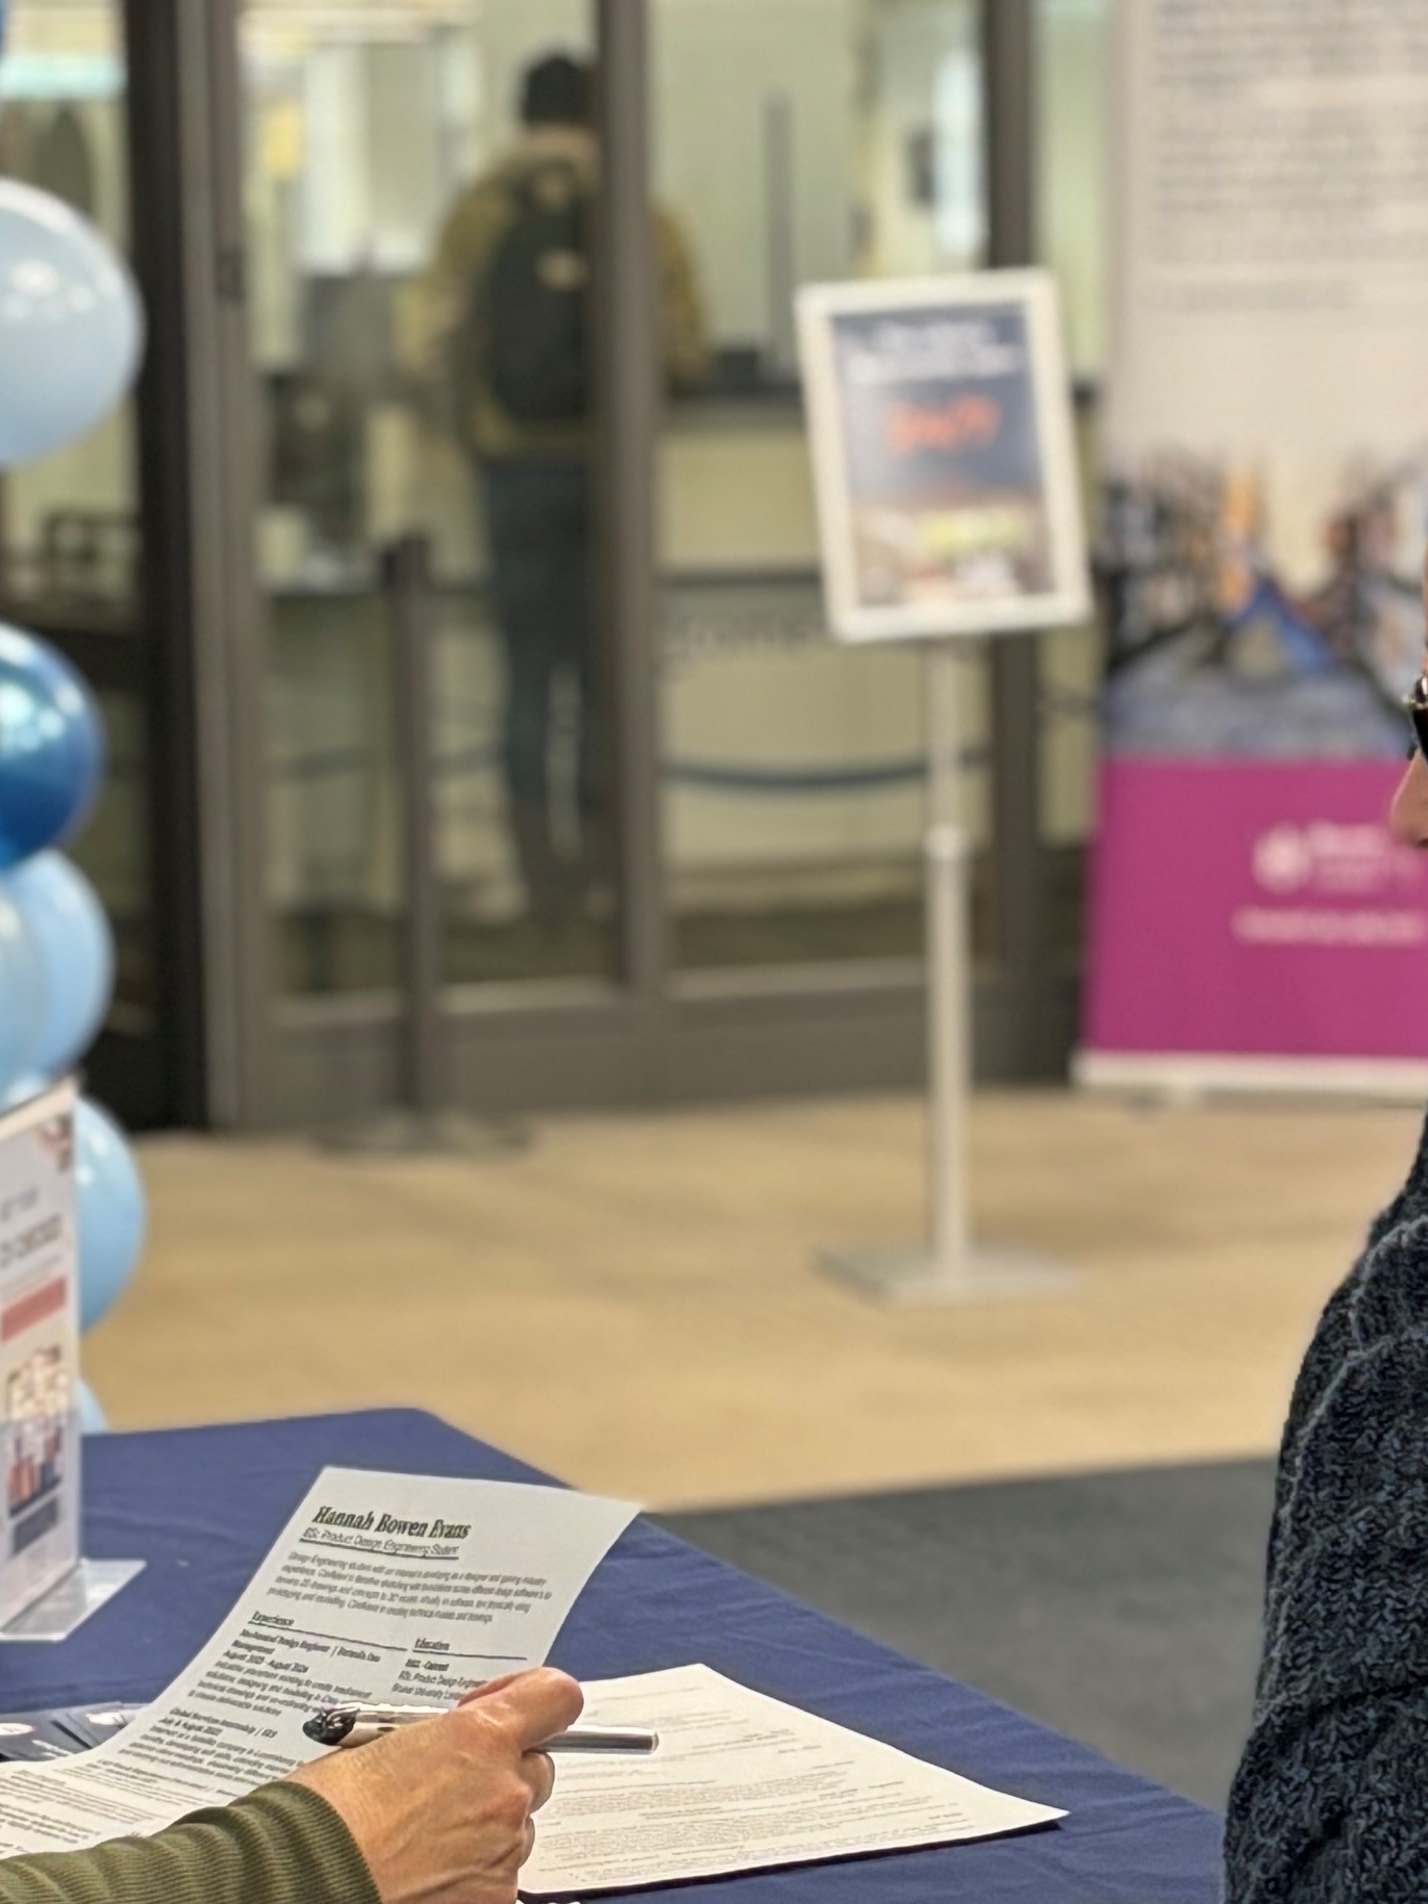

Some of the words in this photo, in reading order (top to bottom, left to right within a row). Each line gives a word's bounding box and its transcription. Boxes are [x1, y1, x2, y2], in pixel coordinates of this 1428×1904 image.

[312, 1506, 374, 1530] Hannah
[375, 1514, 428, 1537] Bowen
[429, 1519, 471, 1540] Evans
